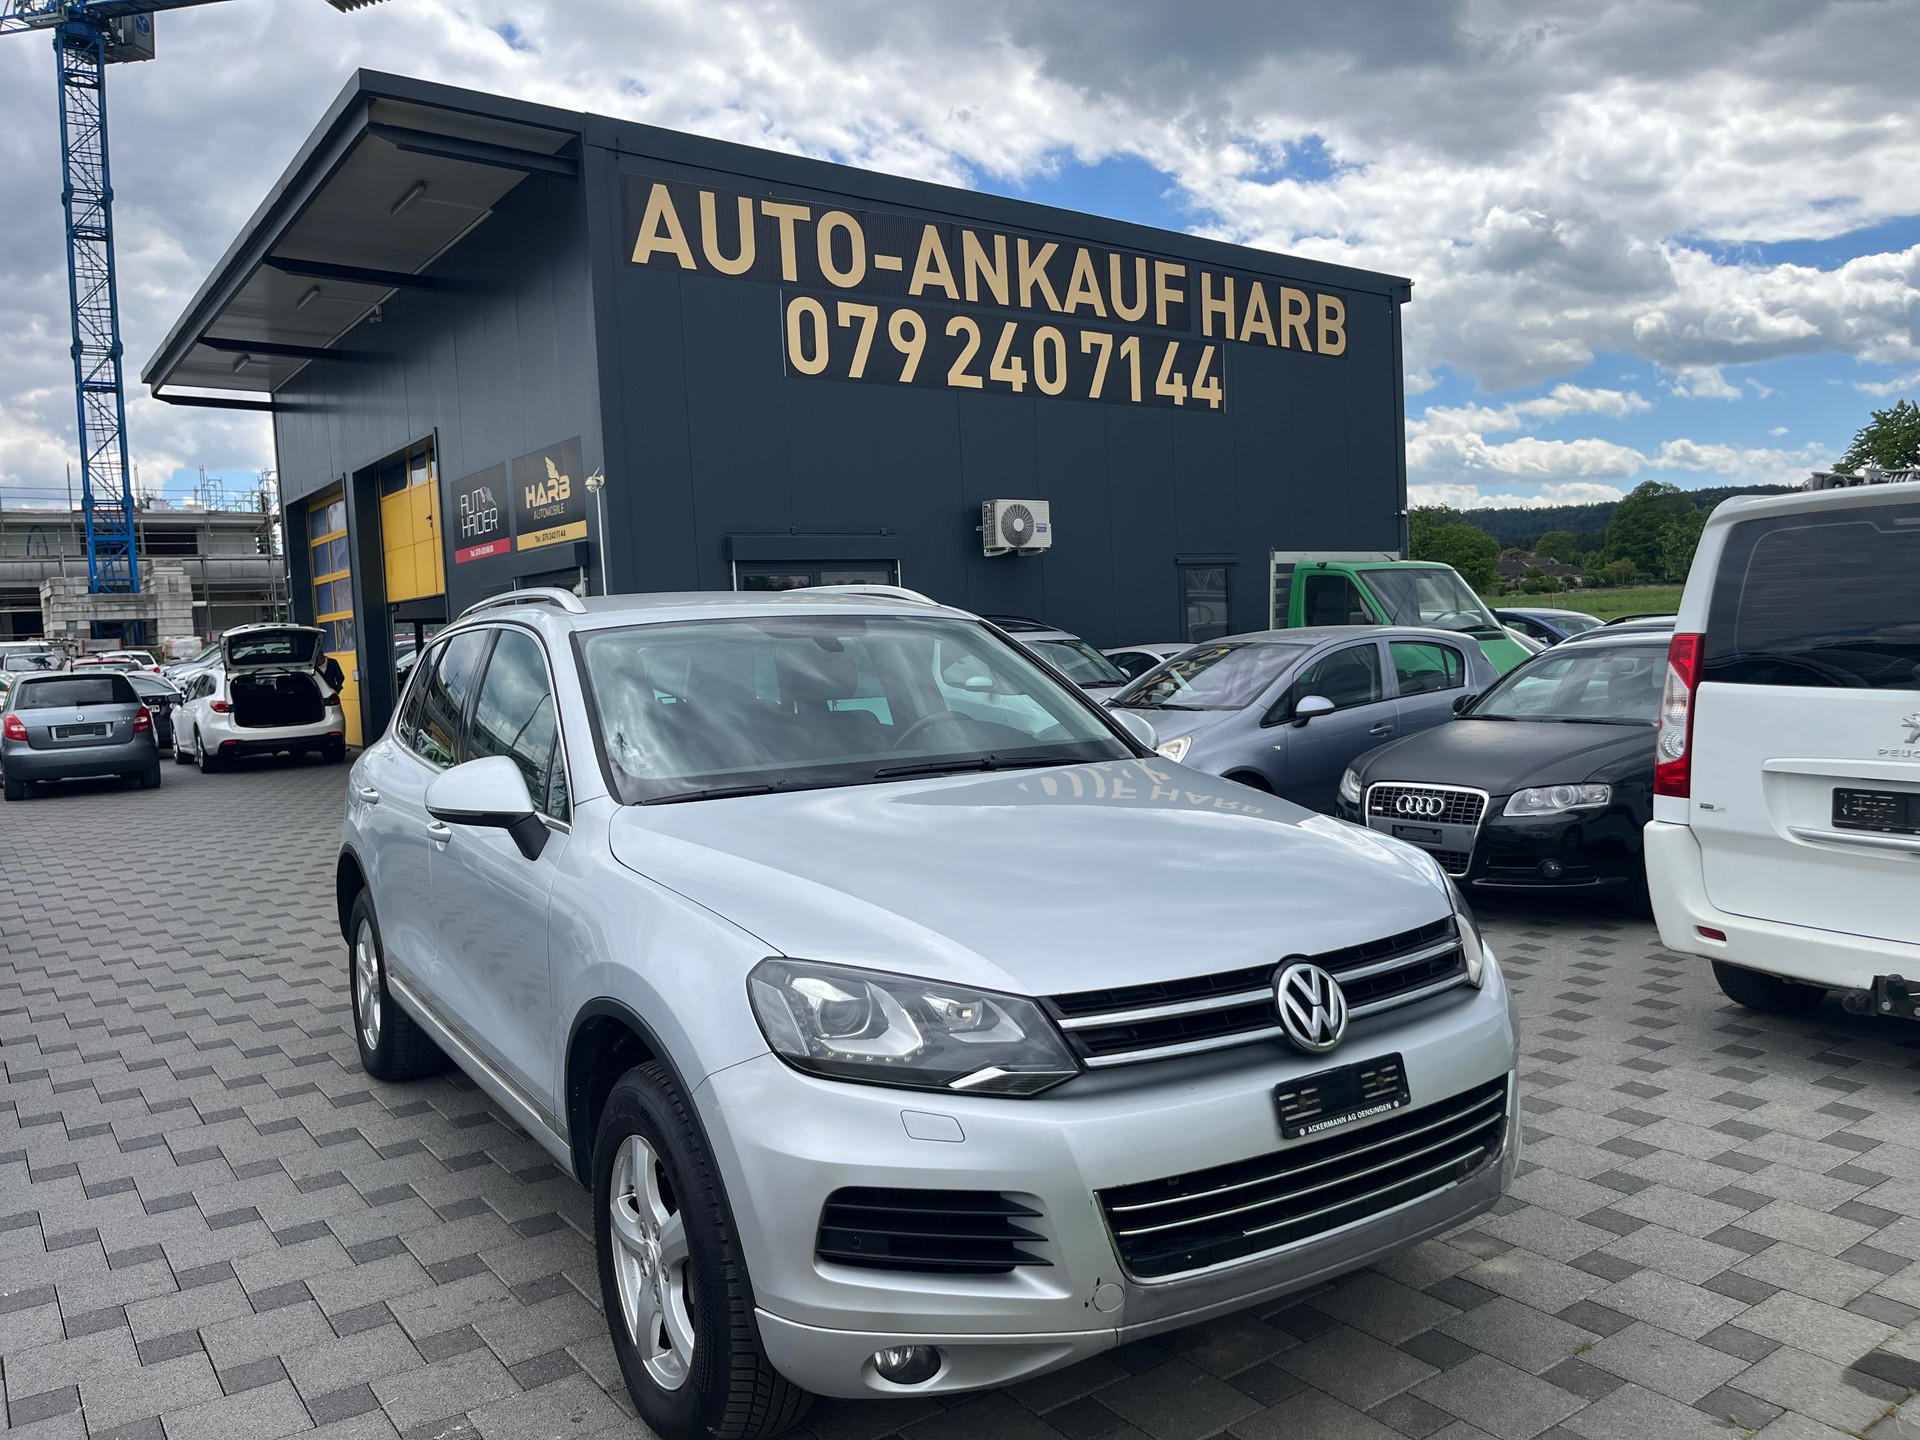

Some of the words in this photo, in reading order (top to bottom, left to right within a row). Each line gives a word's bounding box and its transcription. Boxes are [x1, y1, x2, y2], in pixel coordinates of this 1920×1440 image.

[631, 183, 1187, 326] AUTO-ANKAUF
[1202, 272, 1348, 357] HARB
[786, 296, 928, 384] 079
[946, 315, 1068, 397] 240
[1080, 330, 1142, 404] 71
[1155, 342, 1223, 410] 44
[524, 474, 571, 509] HARB
[461, 507, 499, 539] HAIDER
[533, 502, 565, 521] AUTOMOBILE
[560, 529, 566, 537] 44
[1279, 963, 1348, 1051] VW
[1308, 1115, 1347, 1134] ACKERMANN
[1347, 1113, 1357, 1122] AG
[1357, 1102, 1392, 1119] OENSINGEN
